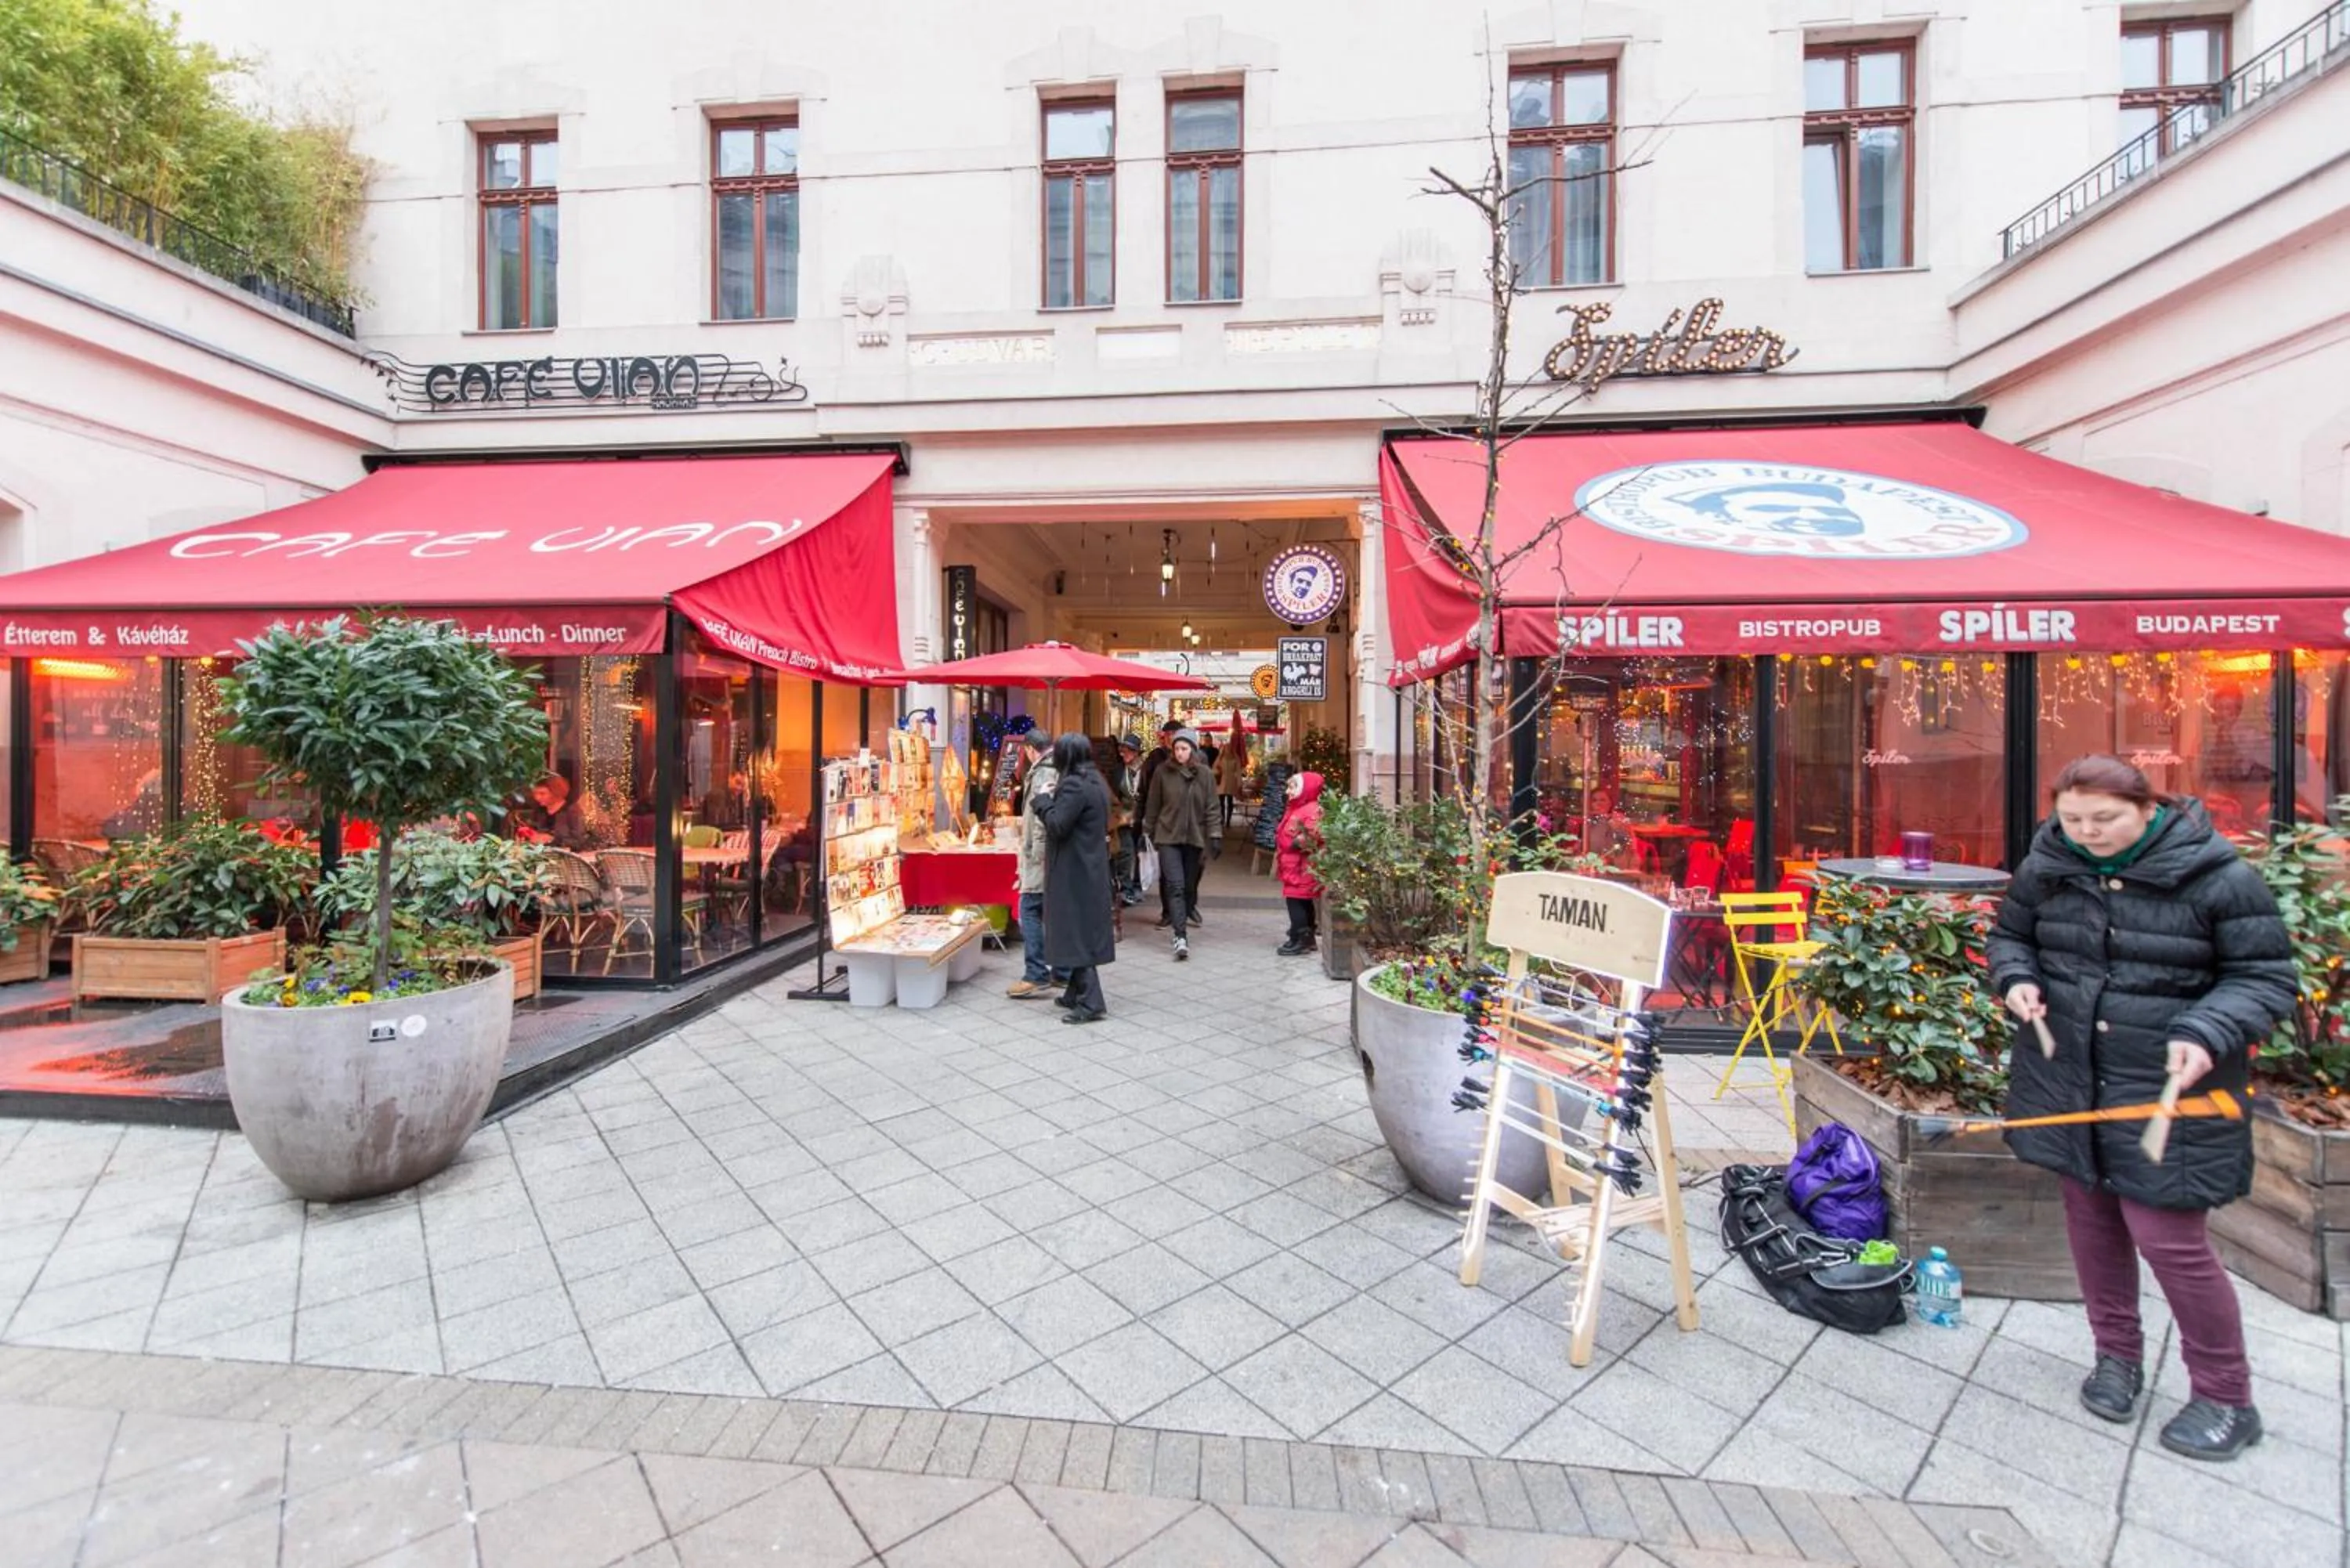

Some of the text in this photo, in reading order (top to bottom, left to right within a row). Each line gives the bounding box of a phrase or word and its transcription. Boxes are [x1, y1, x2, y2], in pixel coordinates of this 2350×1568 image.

[5, 621, 189, 645] Étterem & Kávéház
[487, 624, 544, 643] Lunch
[561, 623, 627, 643] Dinner
[1557, 603, 2280, 647] SPÍLER BISTROPUB SPÍLER BUDAPEST
[757, 639, 789, 661] French
[789, 650, 818, 670] Bistro
[1282, 642, 1310, 652] FOR
[1300, 677, 1321, 685] MÁR
[1538, 894, 1608, 934] TAMAN
